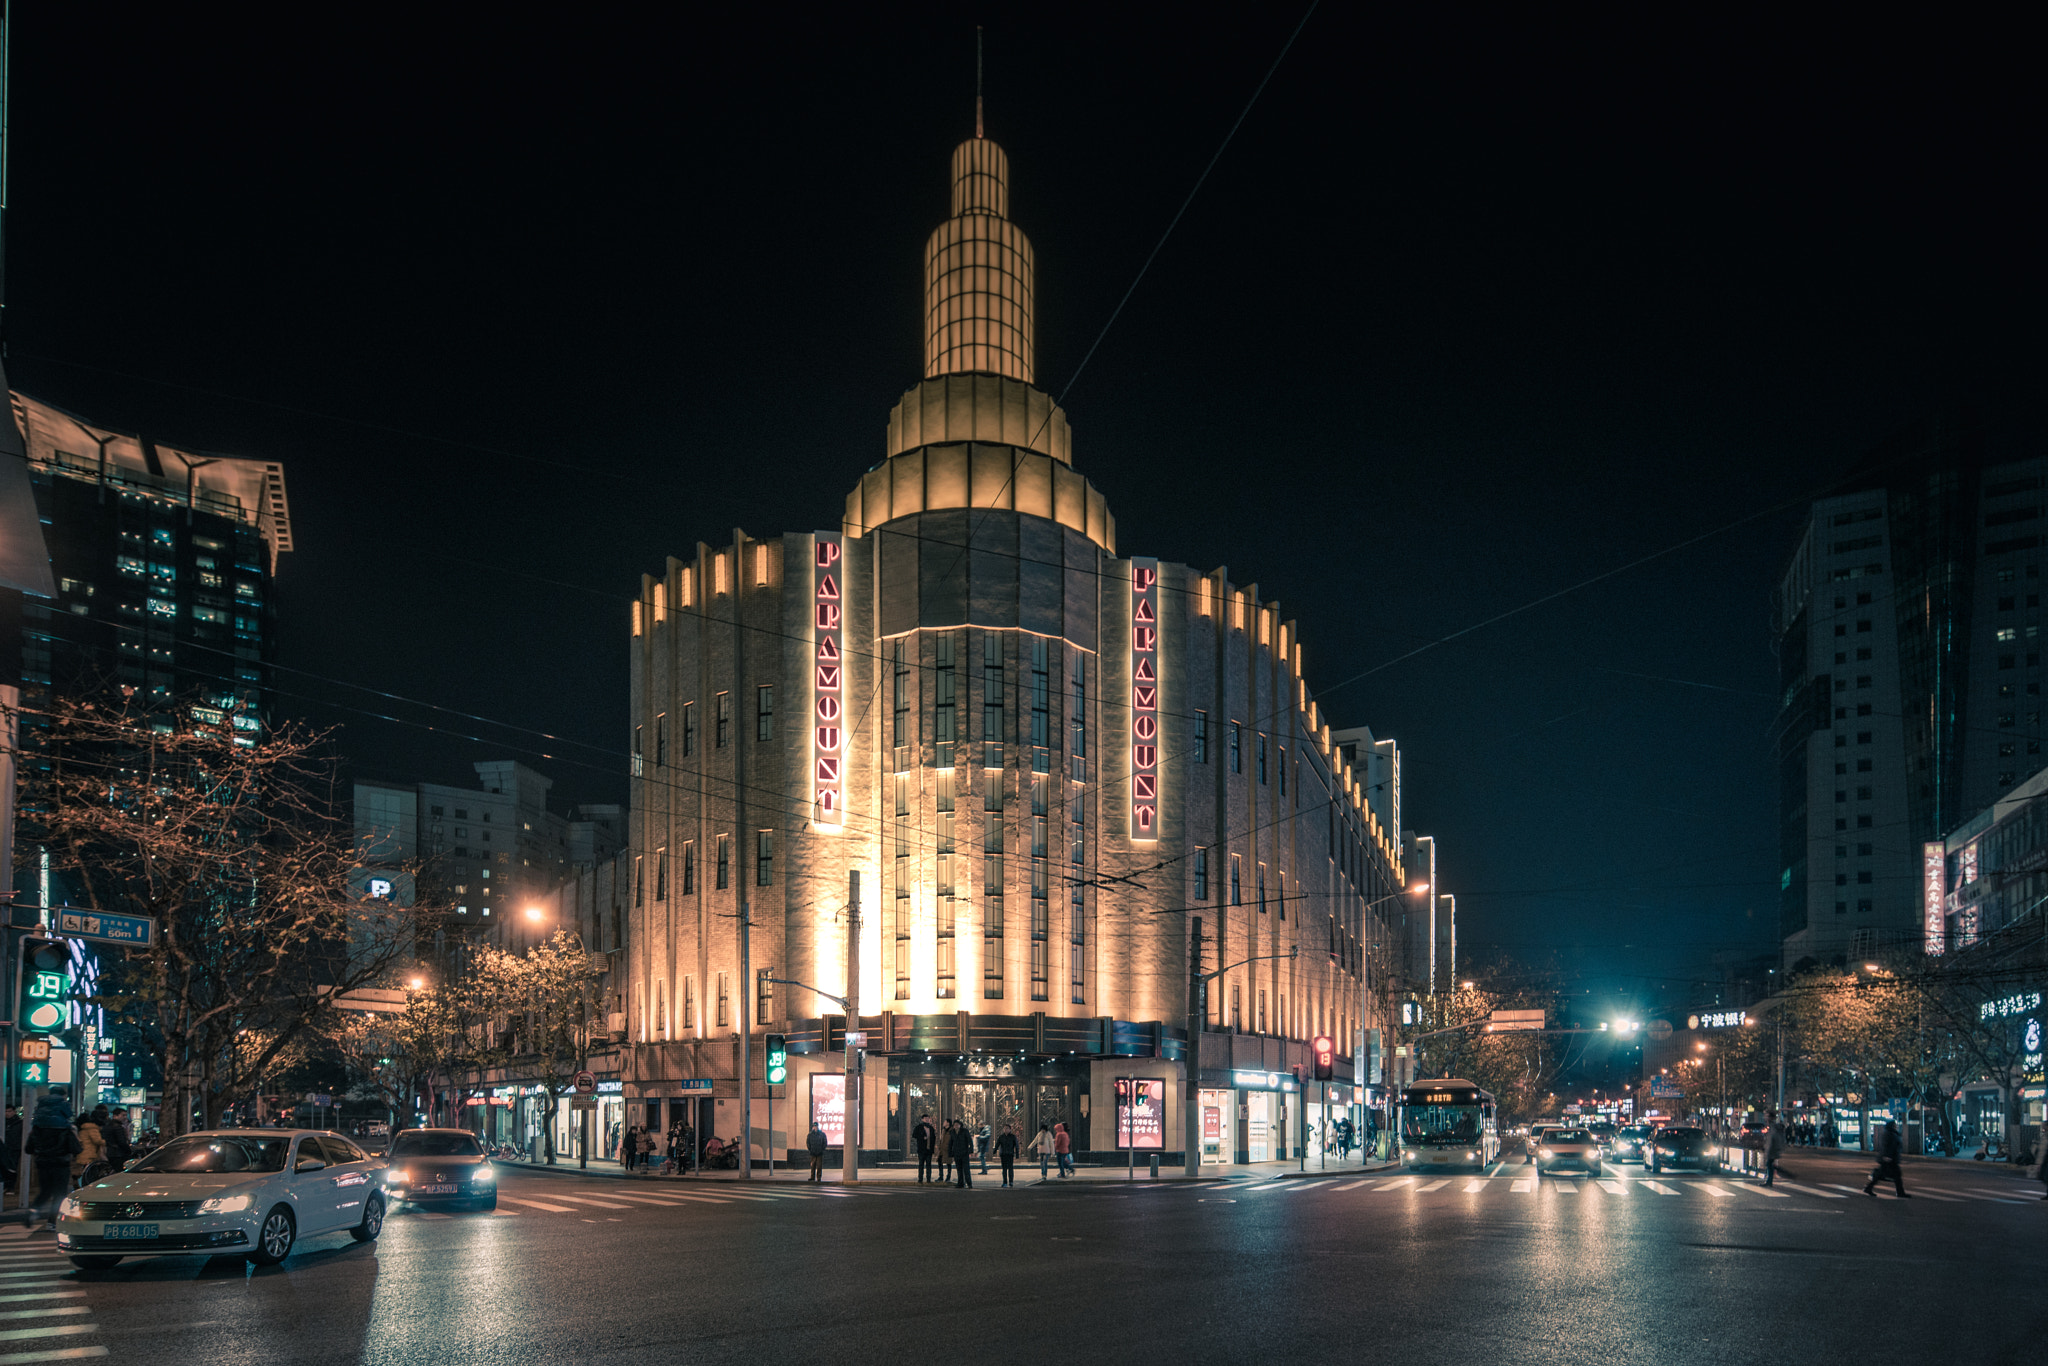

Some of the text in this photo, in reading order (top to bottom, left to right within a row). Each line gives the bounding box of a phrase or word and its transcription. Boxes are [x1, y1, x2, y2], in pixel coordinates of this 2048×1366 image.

[816, 541, 840, 811] PARAMOUNT
[1133, 567, 1156, 828] PARAMOUNT
[371, 879, 391, 898] P
[108, 930, 132, 938] 50m
[23, 1042, 47, 1059] 08
[1321, 1053, 1330, 1066] 13
